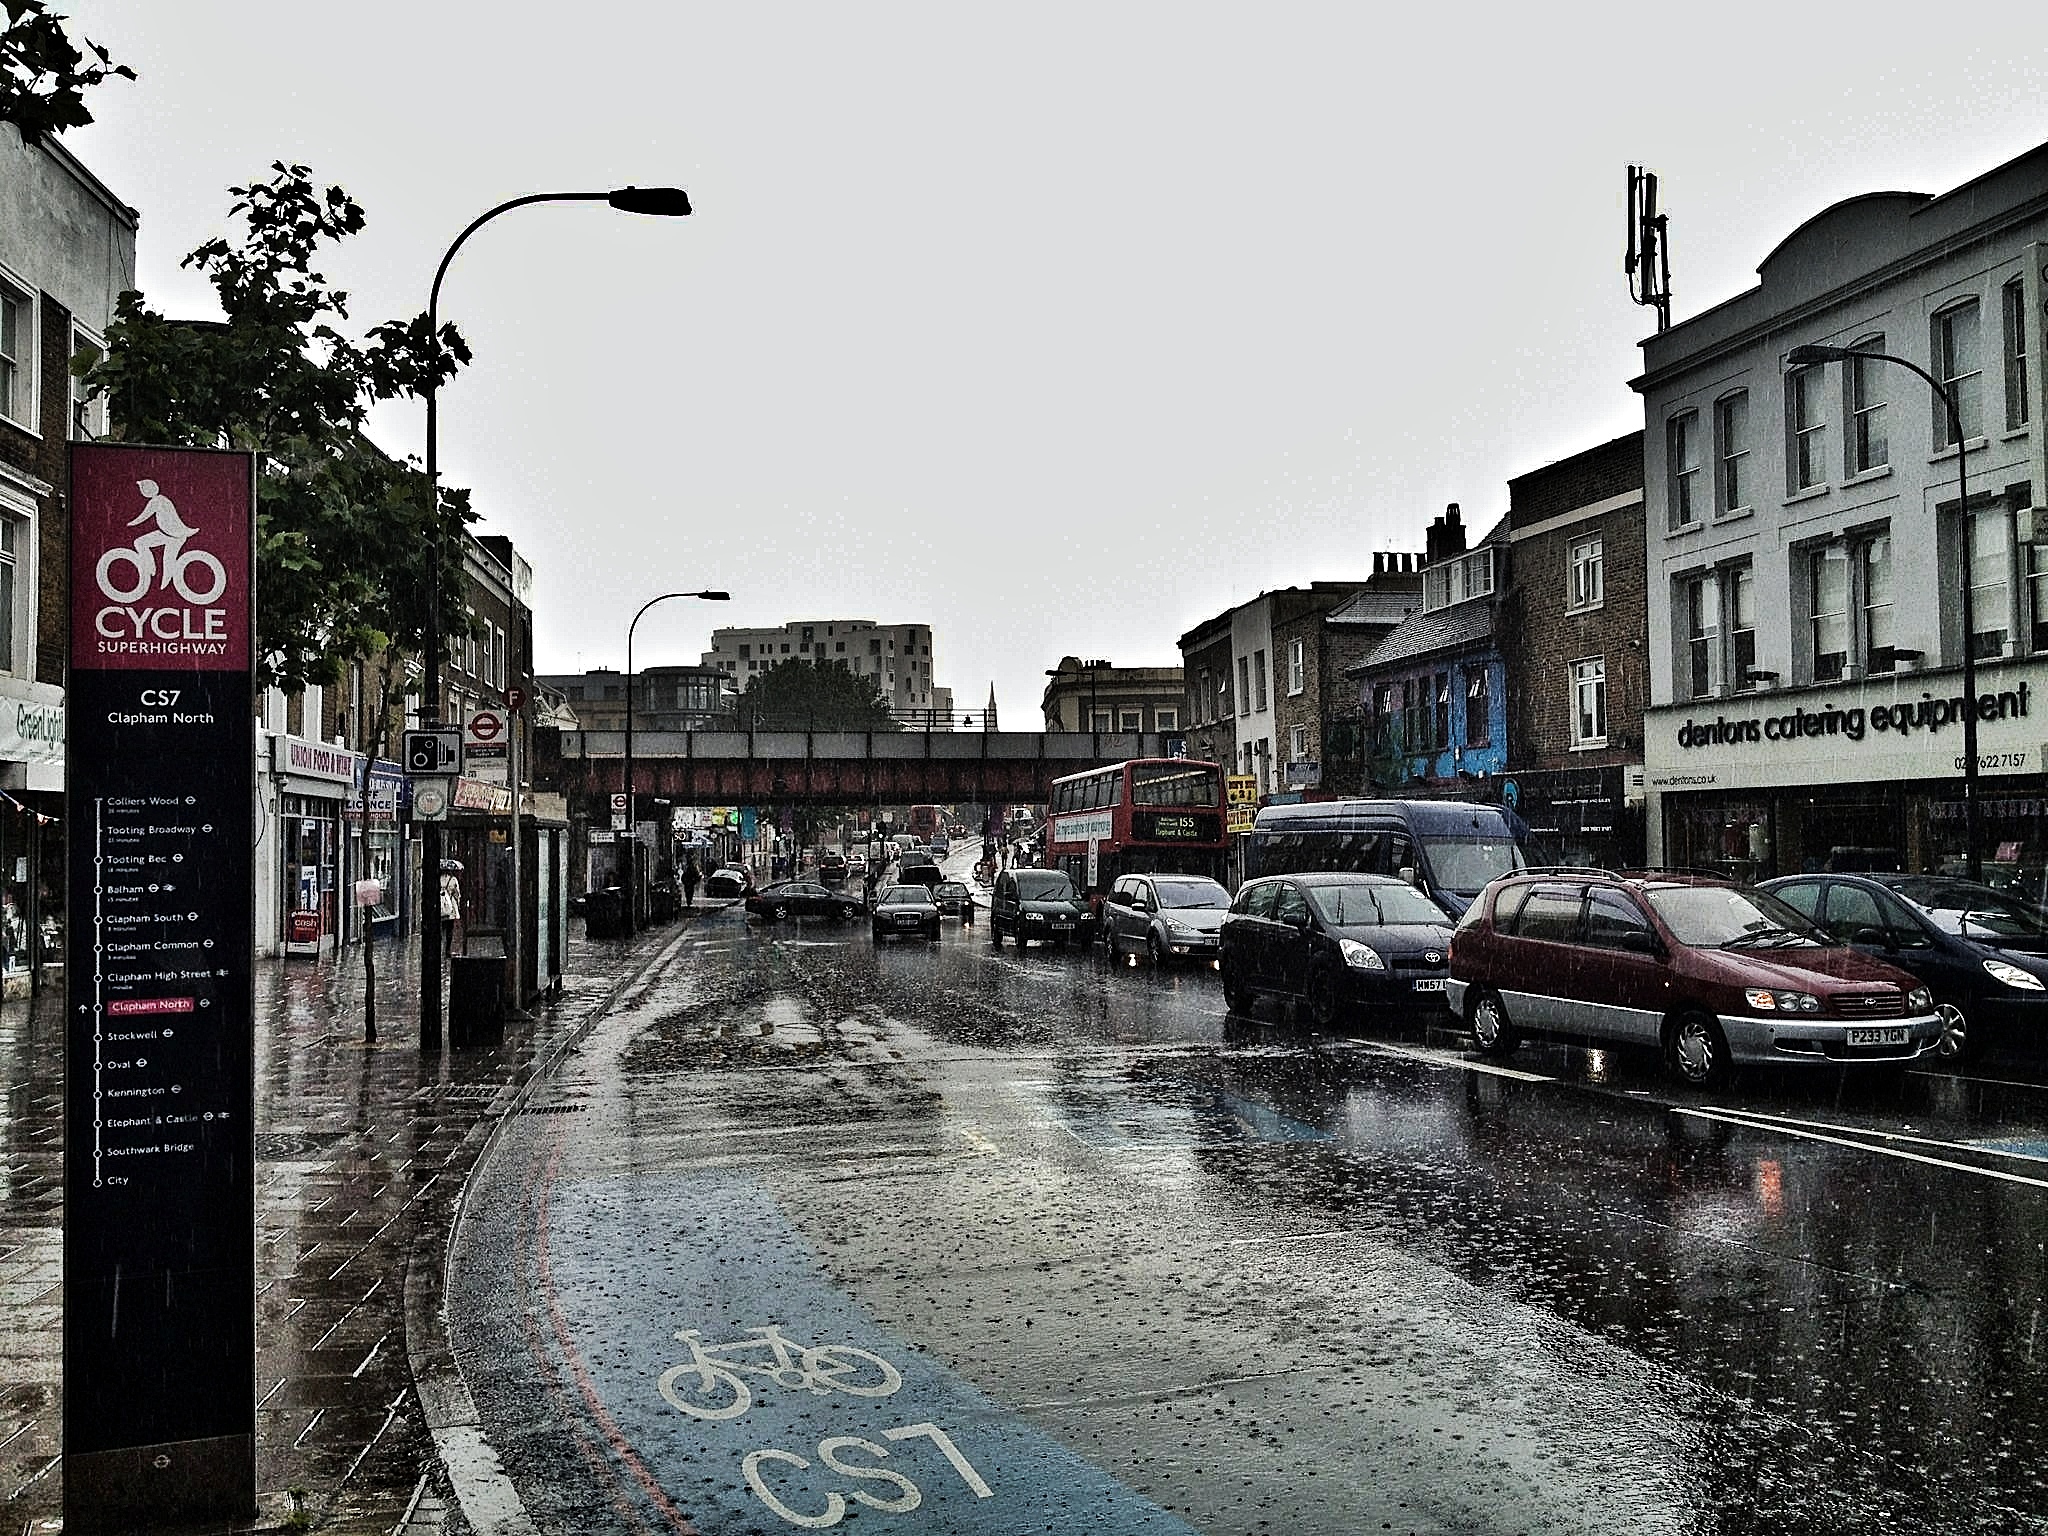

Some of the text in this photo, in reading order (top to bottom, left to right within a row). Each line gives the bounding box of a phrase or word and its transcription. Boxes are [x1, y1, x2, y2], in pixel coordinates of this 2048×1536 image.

[95, 606, 227, 640] CYCLE
[98, 641, 226, 655] SUPERHIGHWAY
[140, 689, 181, 707] CS7
[509, 690, 519, 705] F
[108, 712, 214, 726] Clapham North
[1677, 716, 1761, 748] dentons
[1764, 704, 1866, 741] catering
[2001, 753, 2025, 767] 7157
[107, 797, 179, 806] Colliers Wood
[345, 800, 392, 810] LICNCE
[1180, 817, 1194, 827] 155
[107, 825, 196, 836] Tooting Broadway
[107, 855, 167, 866] Tooting Bec
[107, 885, 144, 894] Balham
[107, 913, 184, 925] Clapham South
[107, 941, 199, 953] Clapham Common
[107, 970, 211, 984] Clapham High Street
[112, 1000, 190, 1013] Clapham North
[107, 1031, 157, 1041] Stockwell
[1851, 1030, 1881, 1043] P233
[107, 1061, 131, 1070] Oval
[107, 1087, 165, 1098] Kennington
[107, 1114, 198, 1128] Elephant & Castle
[107, 1143, 194, 1157] Southwark Bridge
[107, 1176, 129, 1186] City
[741, 1422, 994, 1528] CS7
